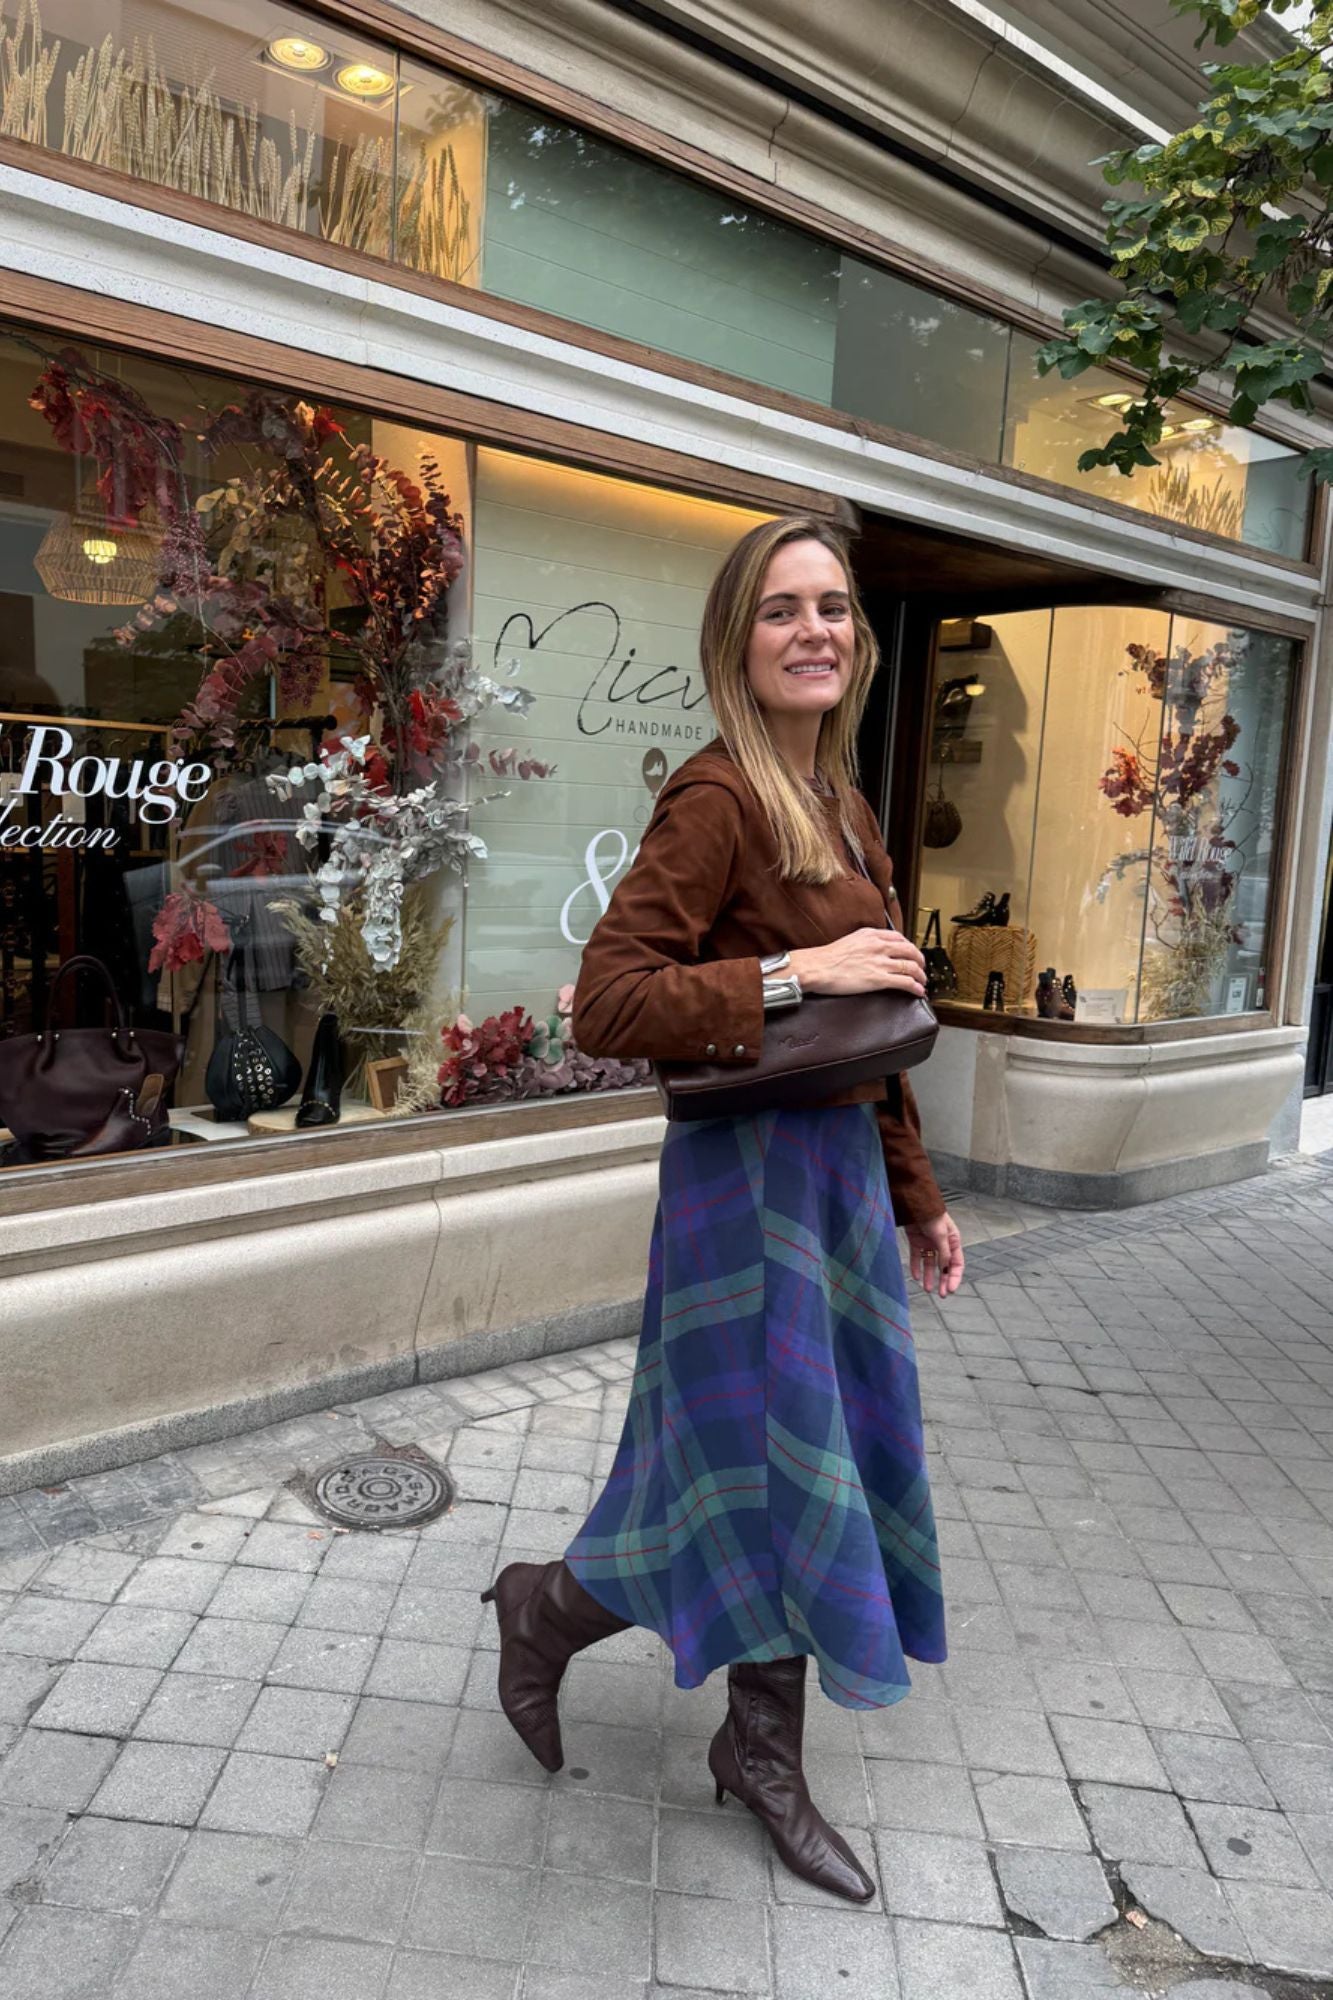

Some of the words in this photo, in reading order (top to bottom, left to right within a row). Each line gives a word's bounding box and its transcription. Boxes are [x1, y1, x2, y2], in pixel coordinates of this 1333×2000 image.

[615, 719, 703, 740] HANDMADE
[10, 725, 212, 825] Rouge
[0, 797, 121, 849] lection
